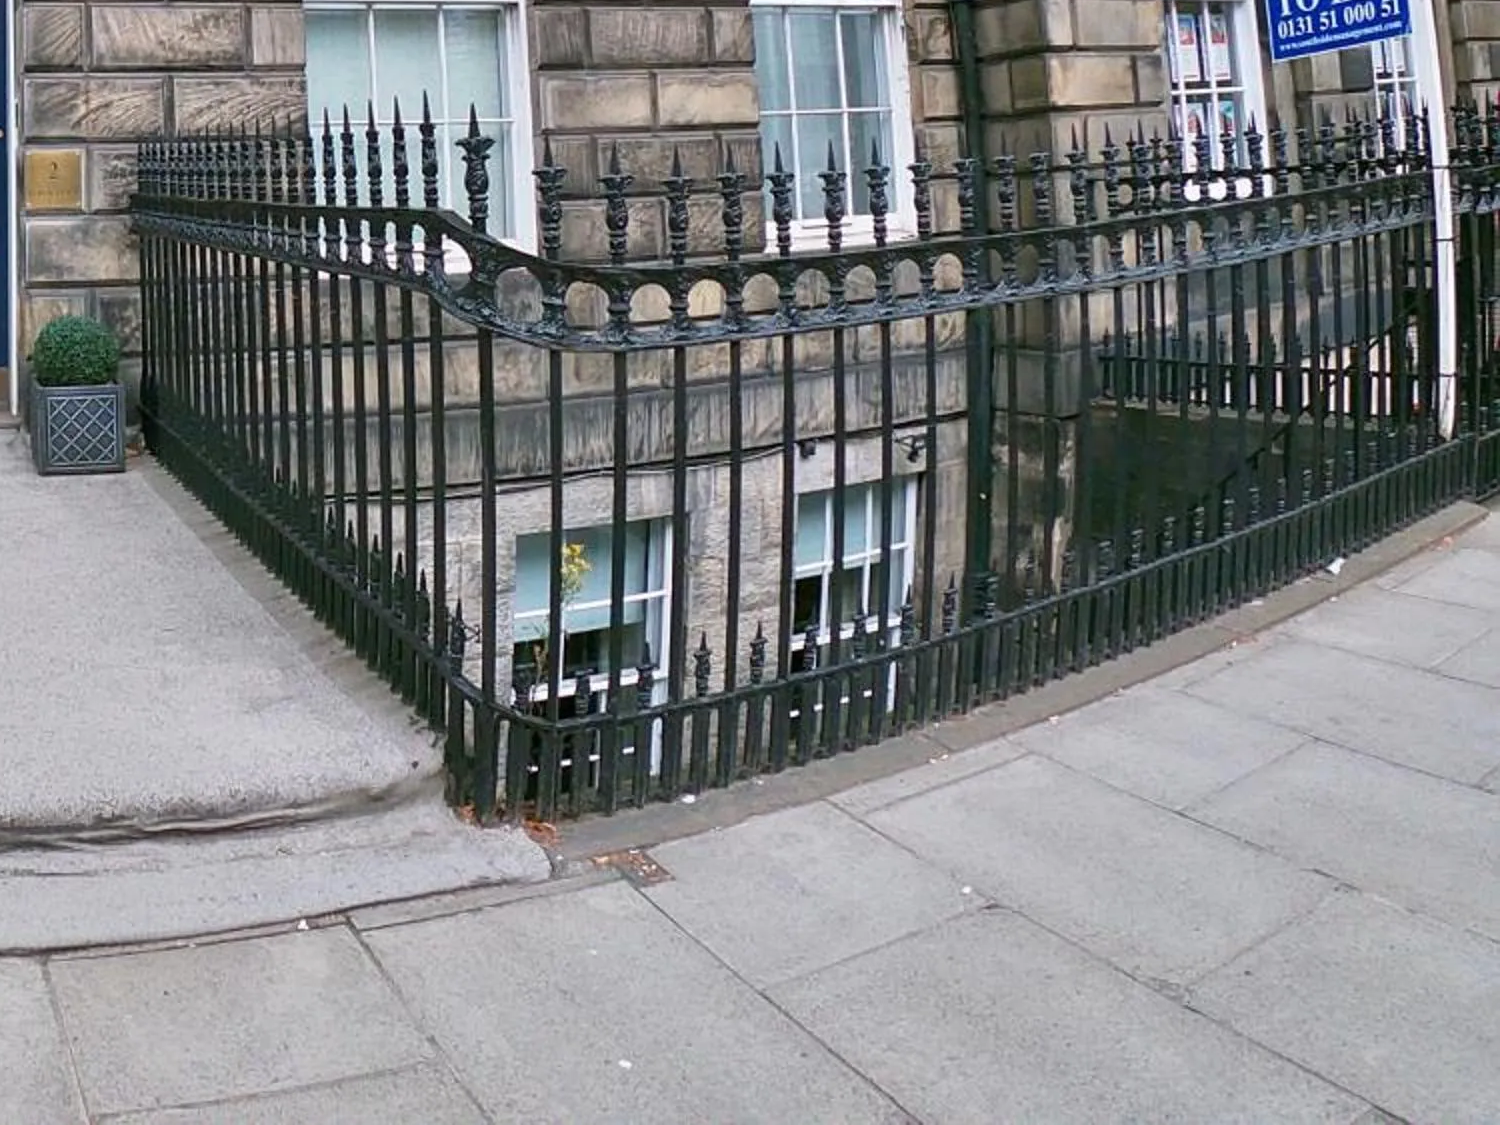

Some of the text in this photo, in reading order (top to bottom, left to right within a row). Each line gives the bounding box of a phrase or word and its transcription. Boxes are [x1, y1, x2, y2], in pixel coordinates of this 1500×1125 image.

[1277, 15, 1315, 39] 0131
[1319, 10, 1339, 31] 51
[1343, 1, 1376, 26] 000
